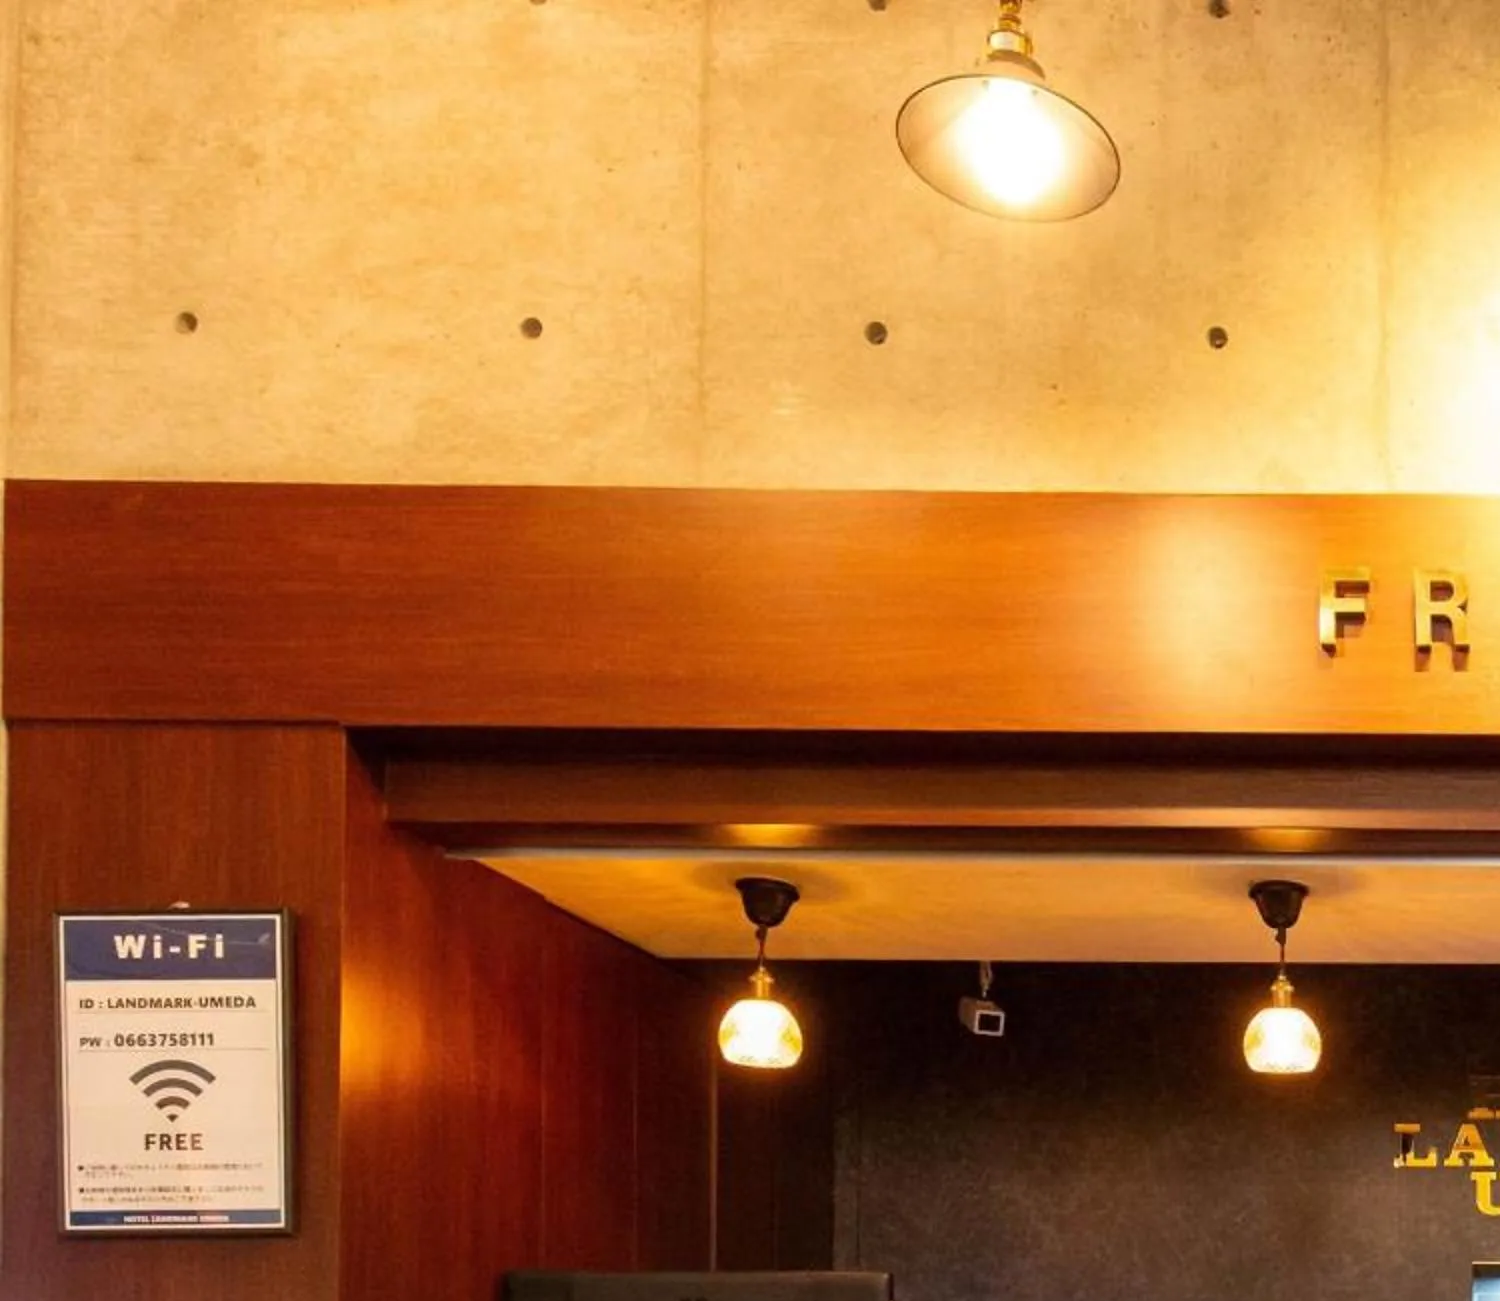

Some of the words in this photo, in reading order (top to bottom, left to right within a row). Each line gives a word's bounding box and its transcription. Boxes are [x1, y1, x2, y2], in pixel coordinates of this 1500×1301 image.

[113, 933, 225, 960] Wi-Fi
[79, 997, 94, 1009] ID
[107, 996, 257, 1009] LANDMARK-UMEDA
[79, 1037, 102, 1048] PW
[114, 1033, 216, 1048] 0663758111
[144, 1133, 204, 1151] FREE
